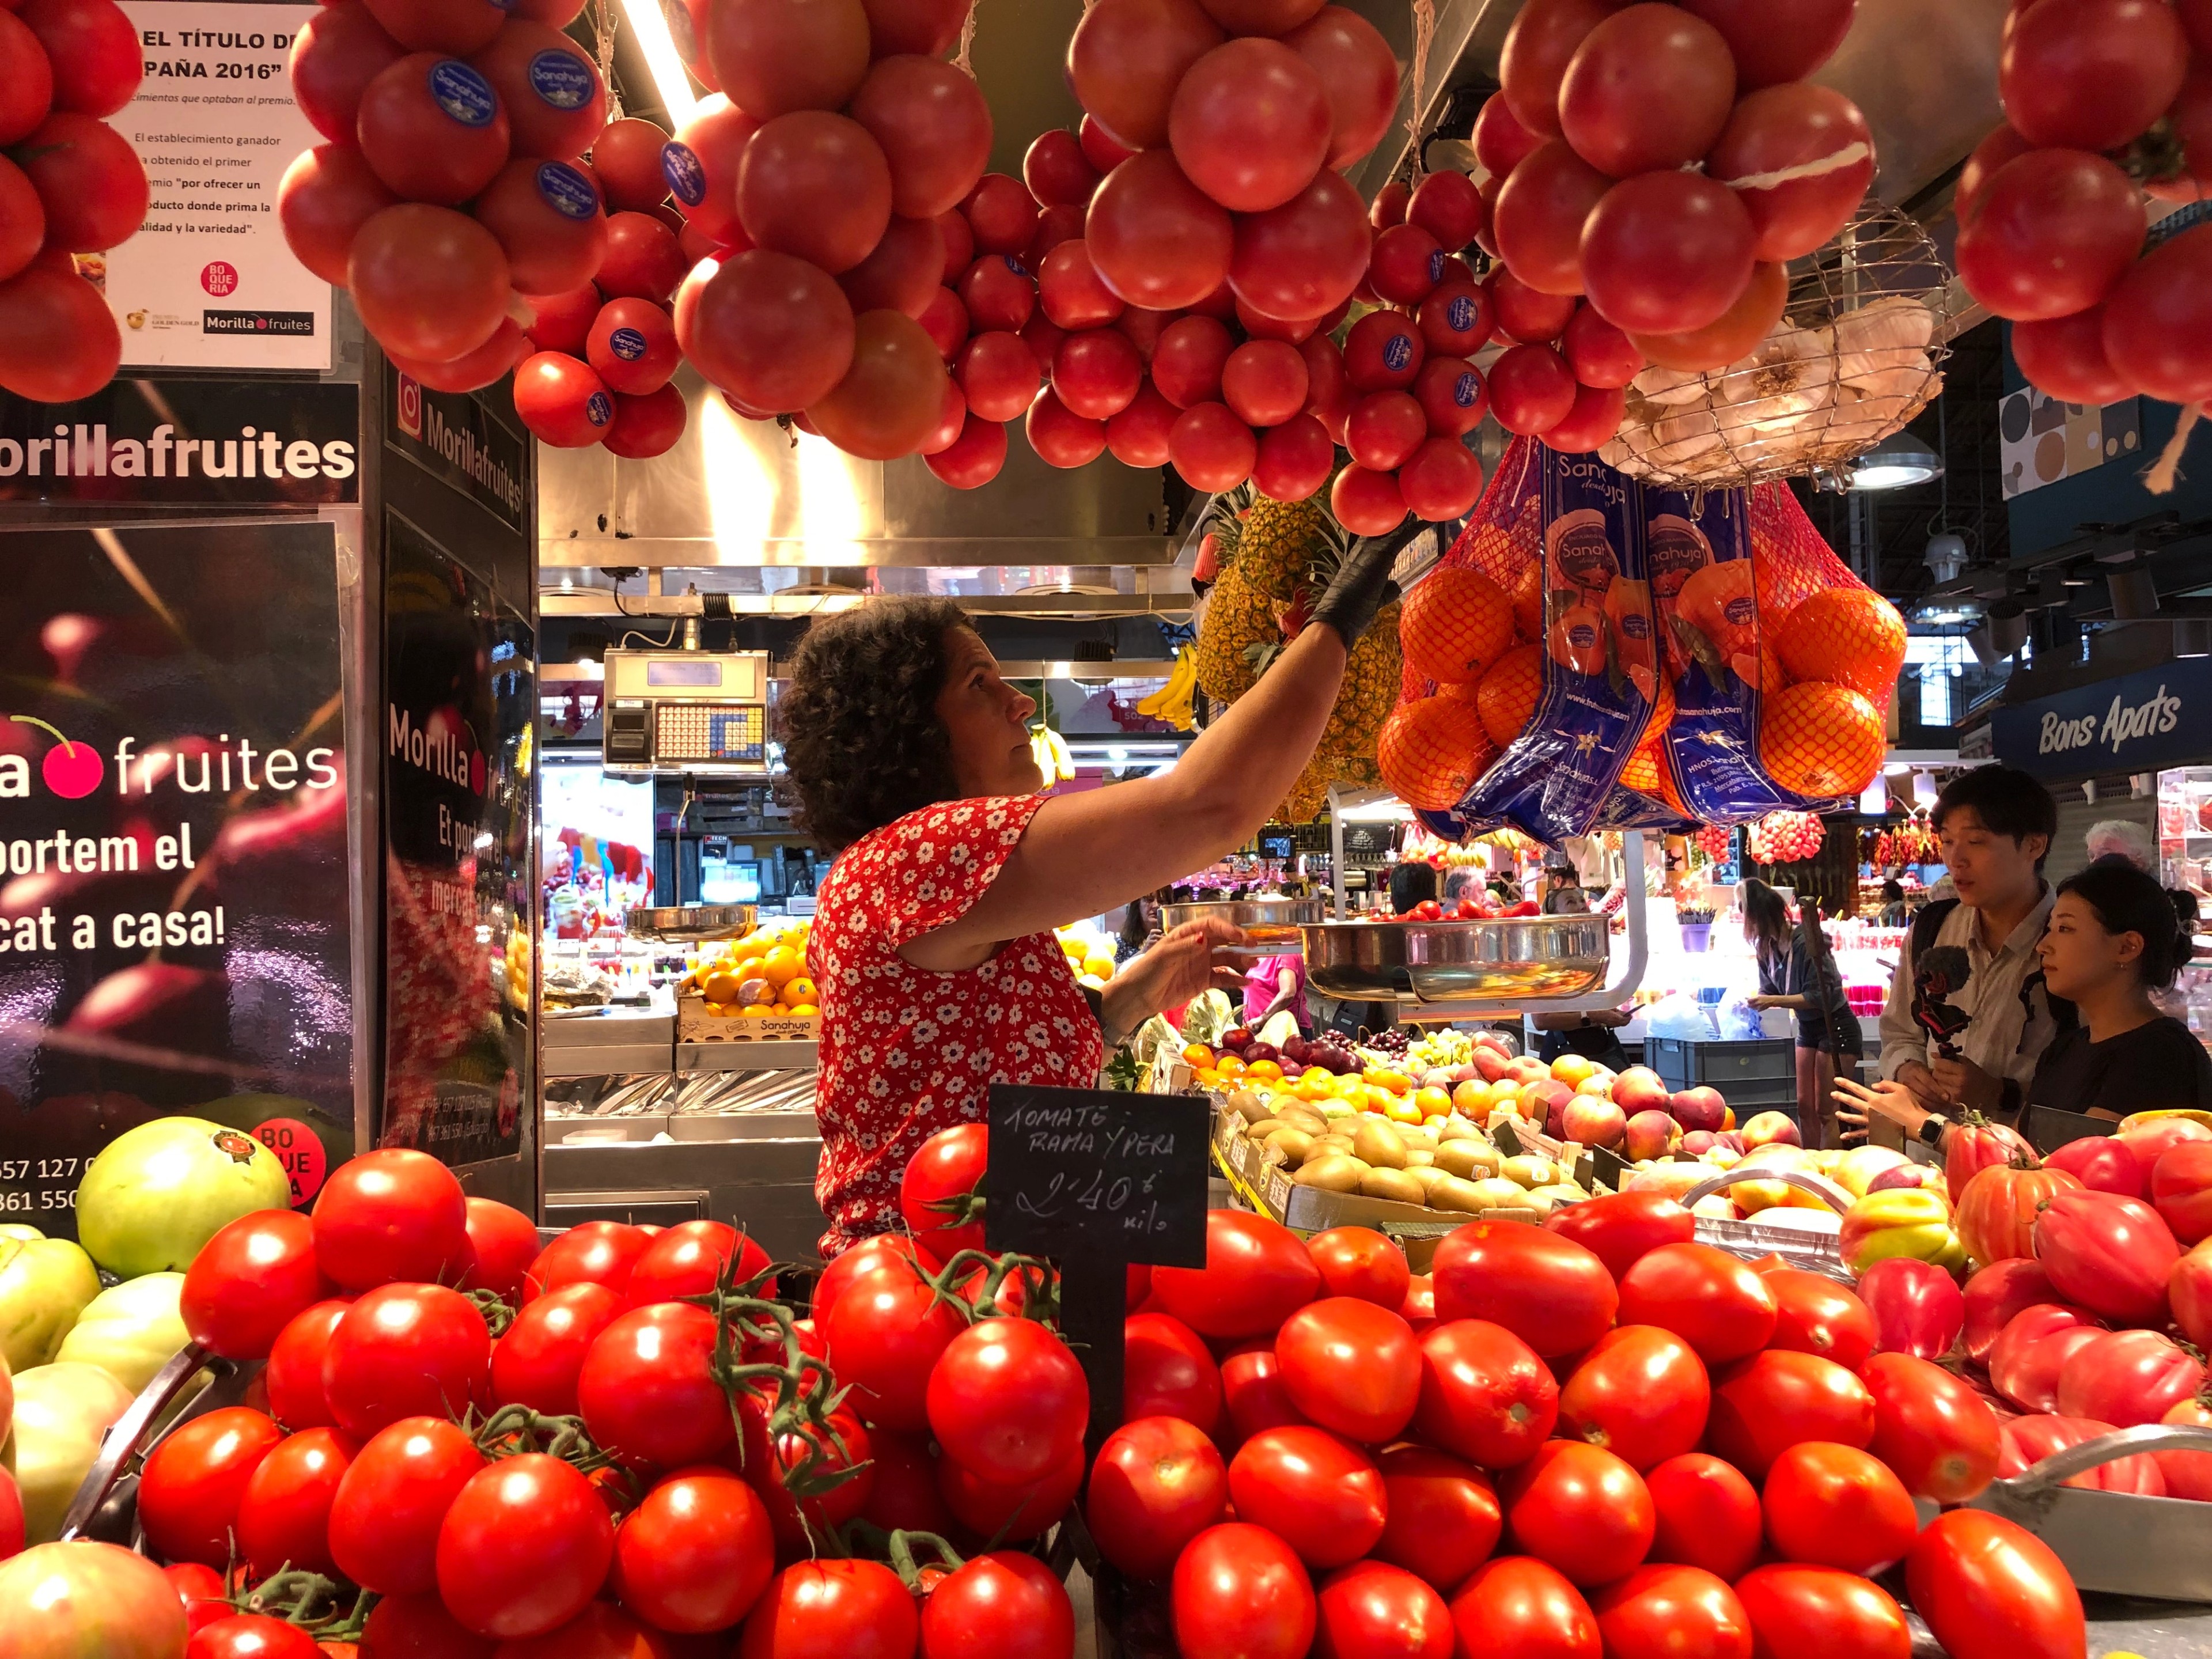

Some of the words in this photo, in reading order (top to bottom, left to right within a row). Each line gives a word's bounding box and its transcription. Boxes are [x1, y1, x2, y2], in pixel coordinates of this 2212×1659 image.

[143, 31, 171, 47] EL
[178, 28, 264, 50] TÍTULO
[181, 95, 200, 106] que
[203, 94, 244, 105] optaban
[246, 94, 256, 104] al
[258, 96, 296, 107] premio.
[135, 133, 144, 142] El
[147, 133, 234, 145] establecimiento
[236, 135, 282, 147] ganador
[150, 156, 200, 166] obtenido
[203, 157, 213, 166] el
[215, 157, 252, 168] primer
[203, 179, 244, 190] ofrecer
[187, 202, 222, 211] donde
[225, 202, 257, 213] prima
[261, 203, 270, 212] la
[176, 225, 182, 234] y
[185, 223, 195, 233] la
[209, 265, 225, 275] BO
[209, 275, 233, 285] QUE
[209, 284, 229, 294] RIA
[207, 317, 255, 329] Morilla
[268, 319, 310, 330] fruites
[428, 402, 521, 512] Morillafruites
[2039, 711, 2097, 756] Bons
[2100, 684, 2181, 754] Apats
[390, 702, 468, 789] Morilla
[114, 733, 339, 796] fruites
[440, 804, 452, 847] Et
[155, 822, 195, 870] el
[72, 914, 96, 950] a
[112, 906, 225, 949] casa!
[761, 1020, 810, 1032] Sanahuja
[261, 1128, 293, 1148] BO
[1029, 1131, 1094, 1152] RAMA
[0, 1160, 30, 1180] 57
[37, 1157, 78, 1178] 127
